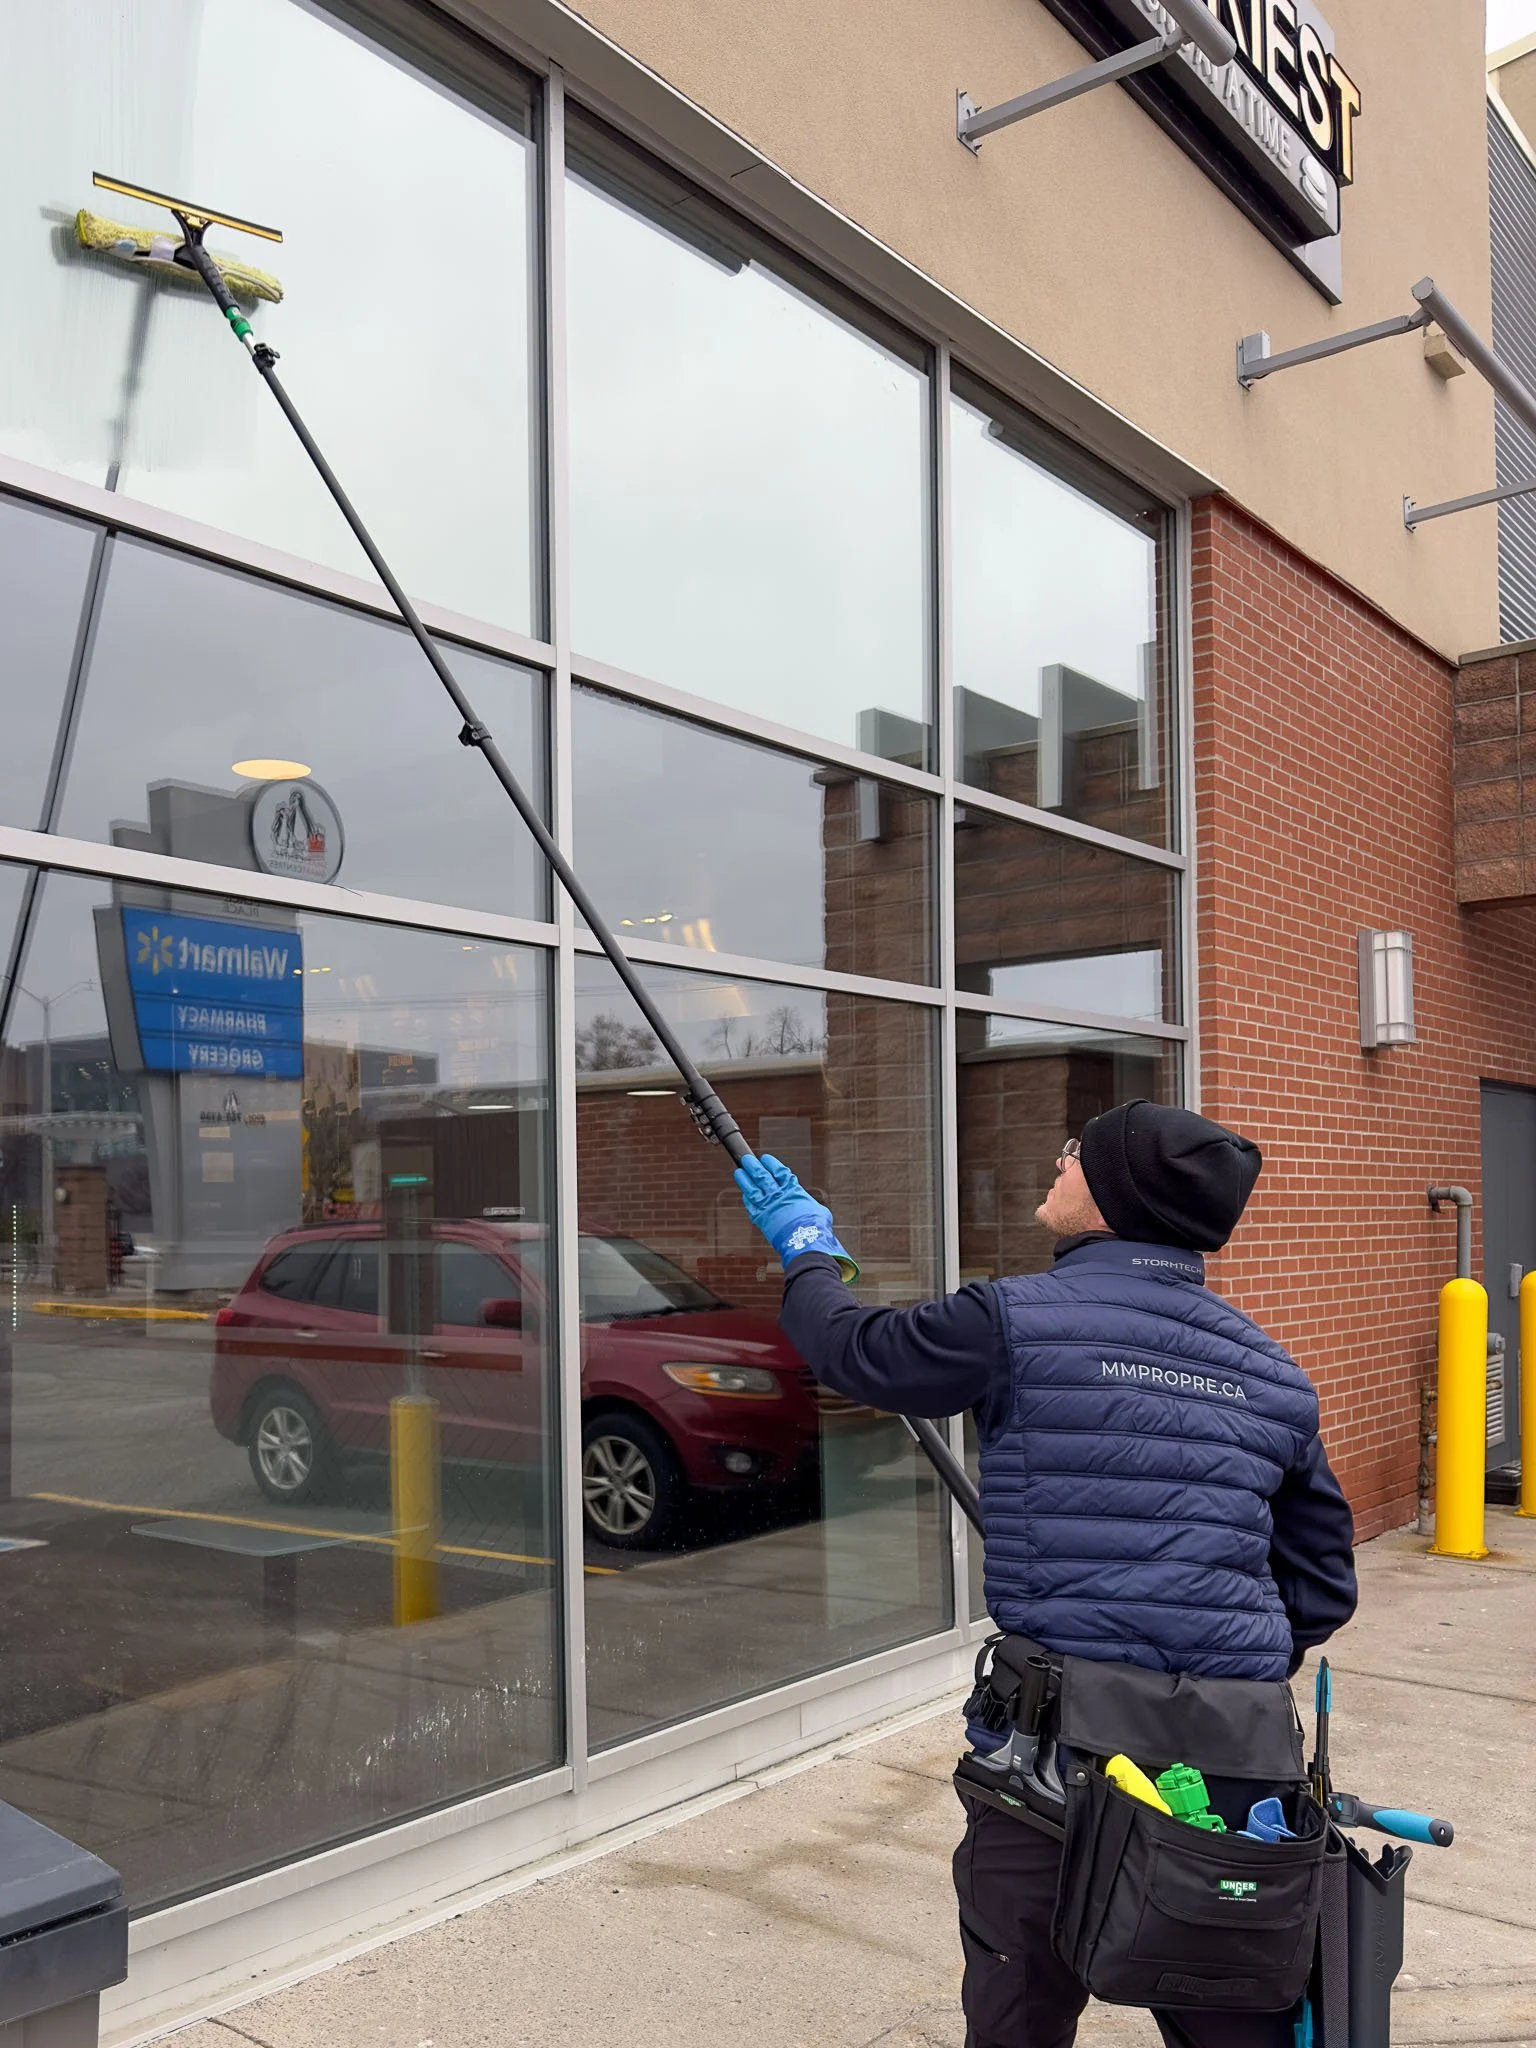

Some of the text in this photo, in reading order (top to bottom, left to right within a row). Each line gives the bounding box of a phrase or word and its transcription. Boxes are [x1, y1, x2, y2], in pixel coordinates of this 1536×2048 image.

[1240, 82, 1293, 169] TIME
[1131, 1257, 1202, 1274] STORMTECH
[1101, 1360, 1247, 1401] MMPROPRE.CA
